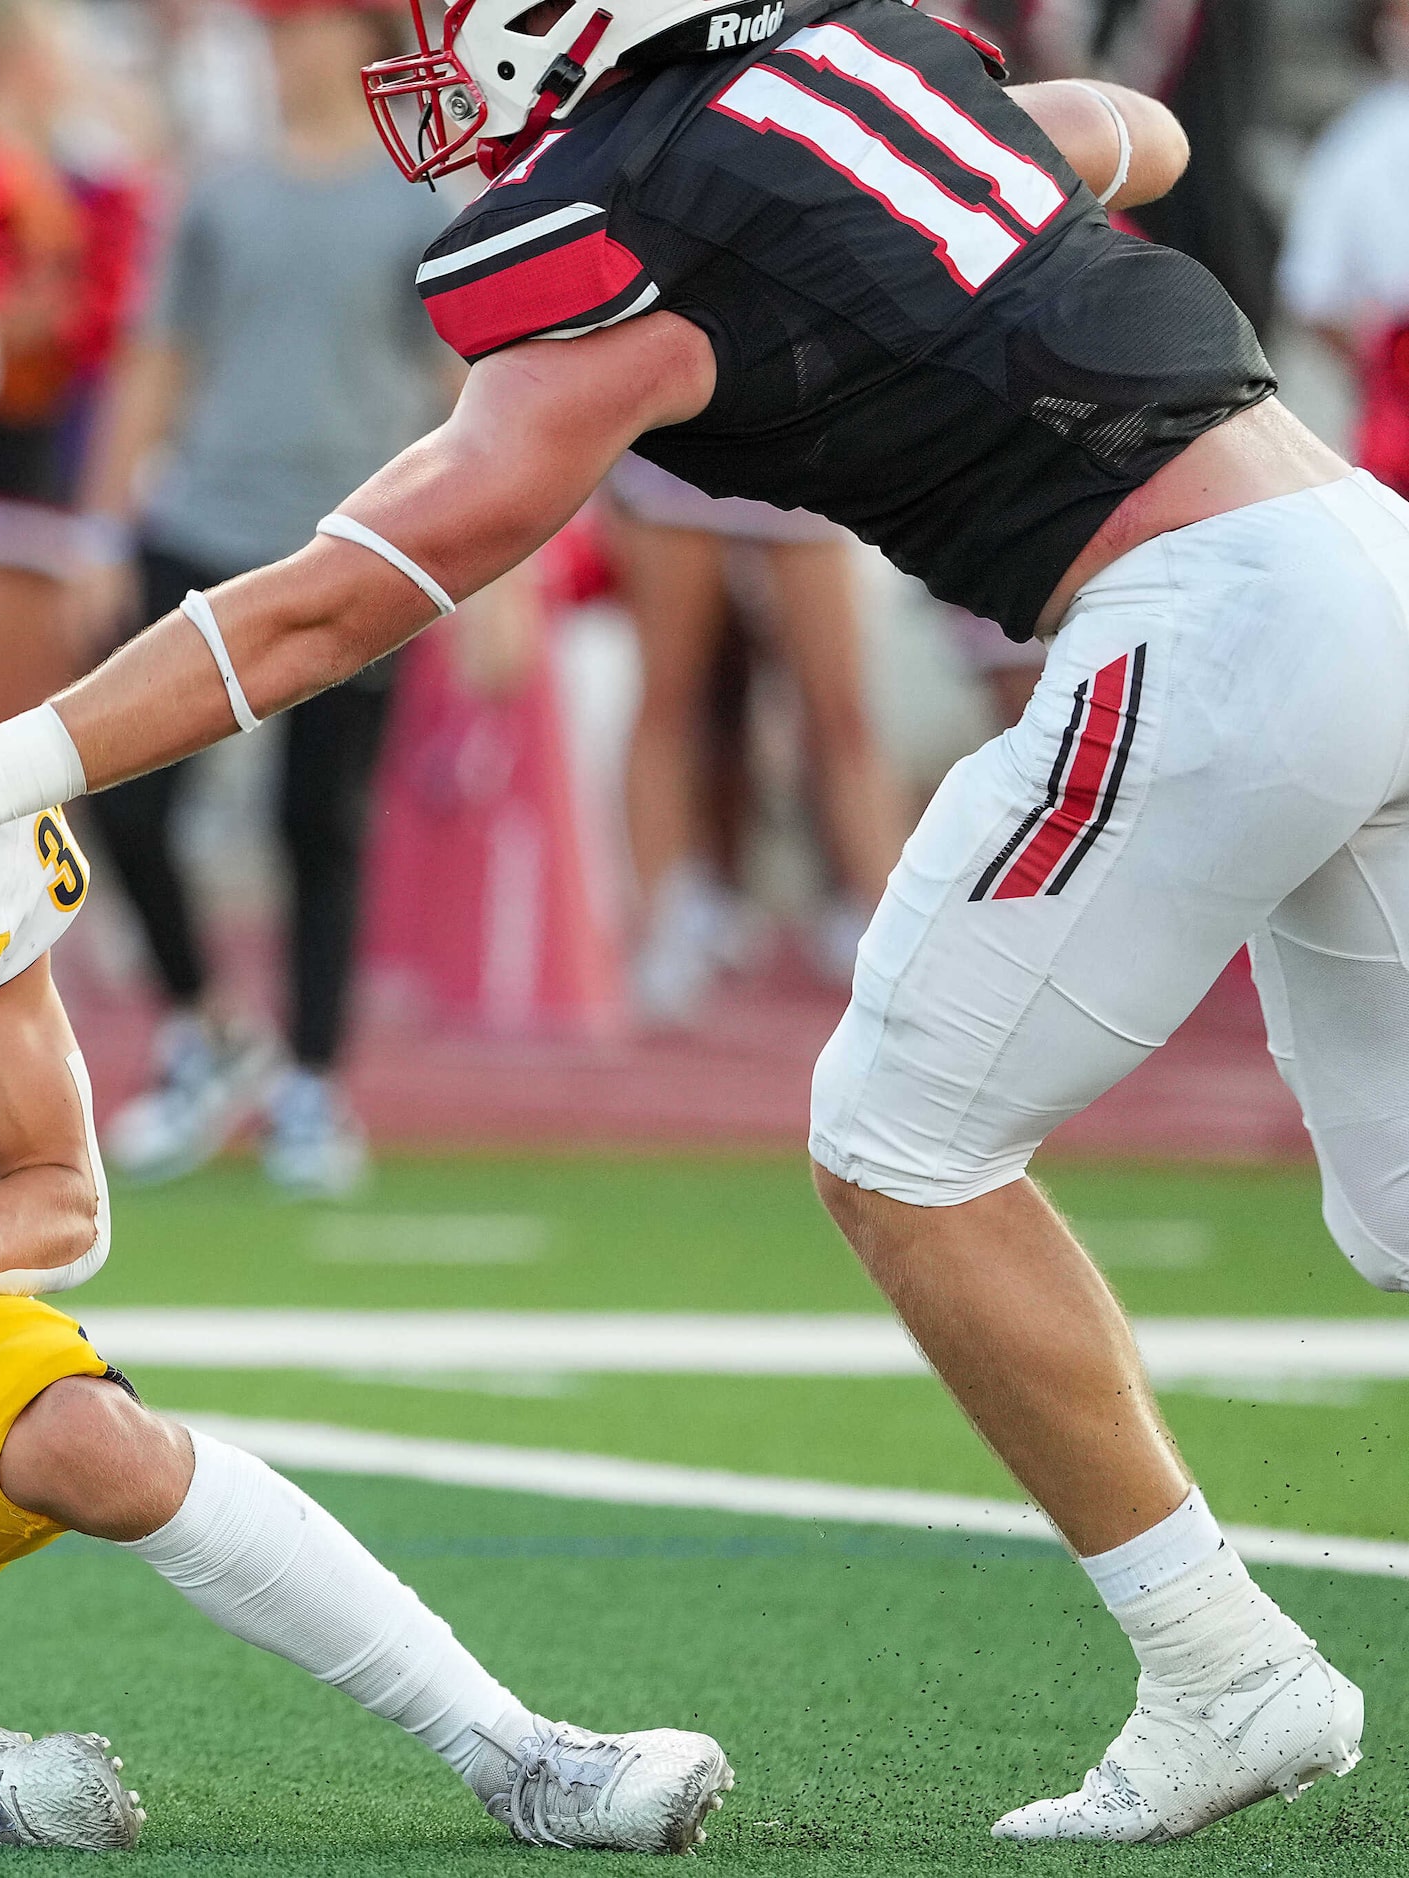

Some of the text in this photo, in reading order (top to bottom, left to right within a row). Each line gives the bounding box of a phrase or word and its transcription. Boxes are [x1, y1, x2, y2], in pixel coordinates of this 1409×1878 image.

[706, 1, 785, 51] Ridd
[707, 21, 1068, 297] 11
[33, 804, 88, 913] 3
